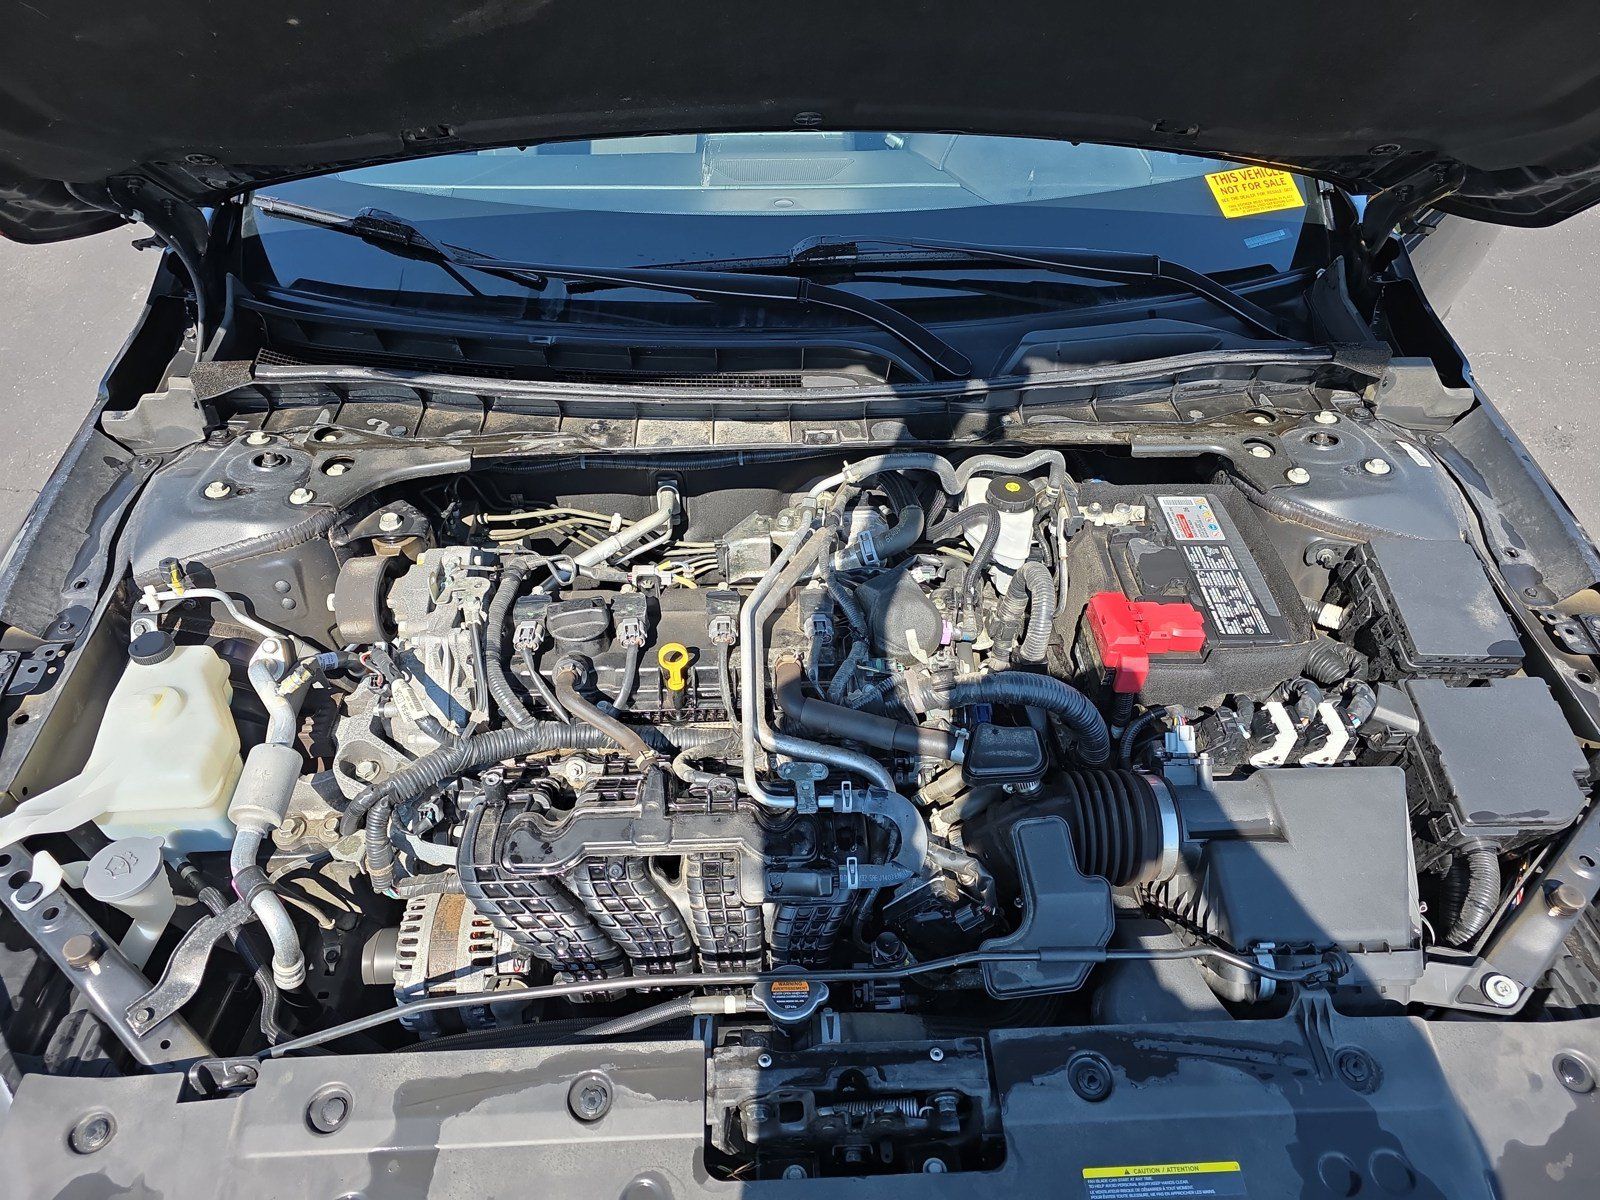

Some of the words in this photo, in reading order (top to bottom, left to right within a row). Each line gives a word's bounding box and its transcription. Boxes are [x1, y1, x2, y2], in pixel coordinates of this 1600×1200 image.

[1212, 173, 1238, 186] THIS
[1220, 186, 1240, 195] NOT
[1242, 182, 1262, 191] FOR
[1263, 178, 1287, 188] SALE
